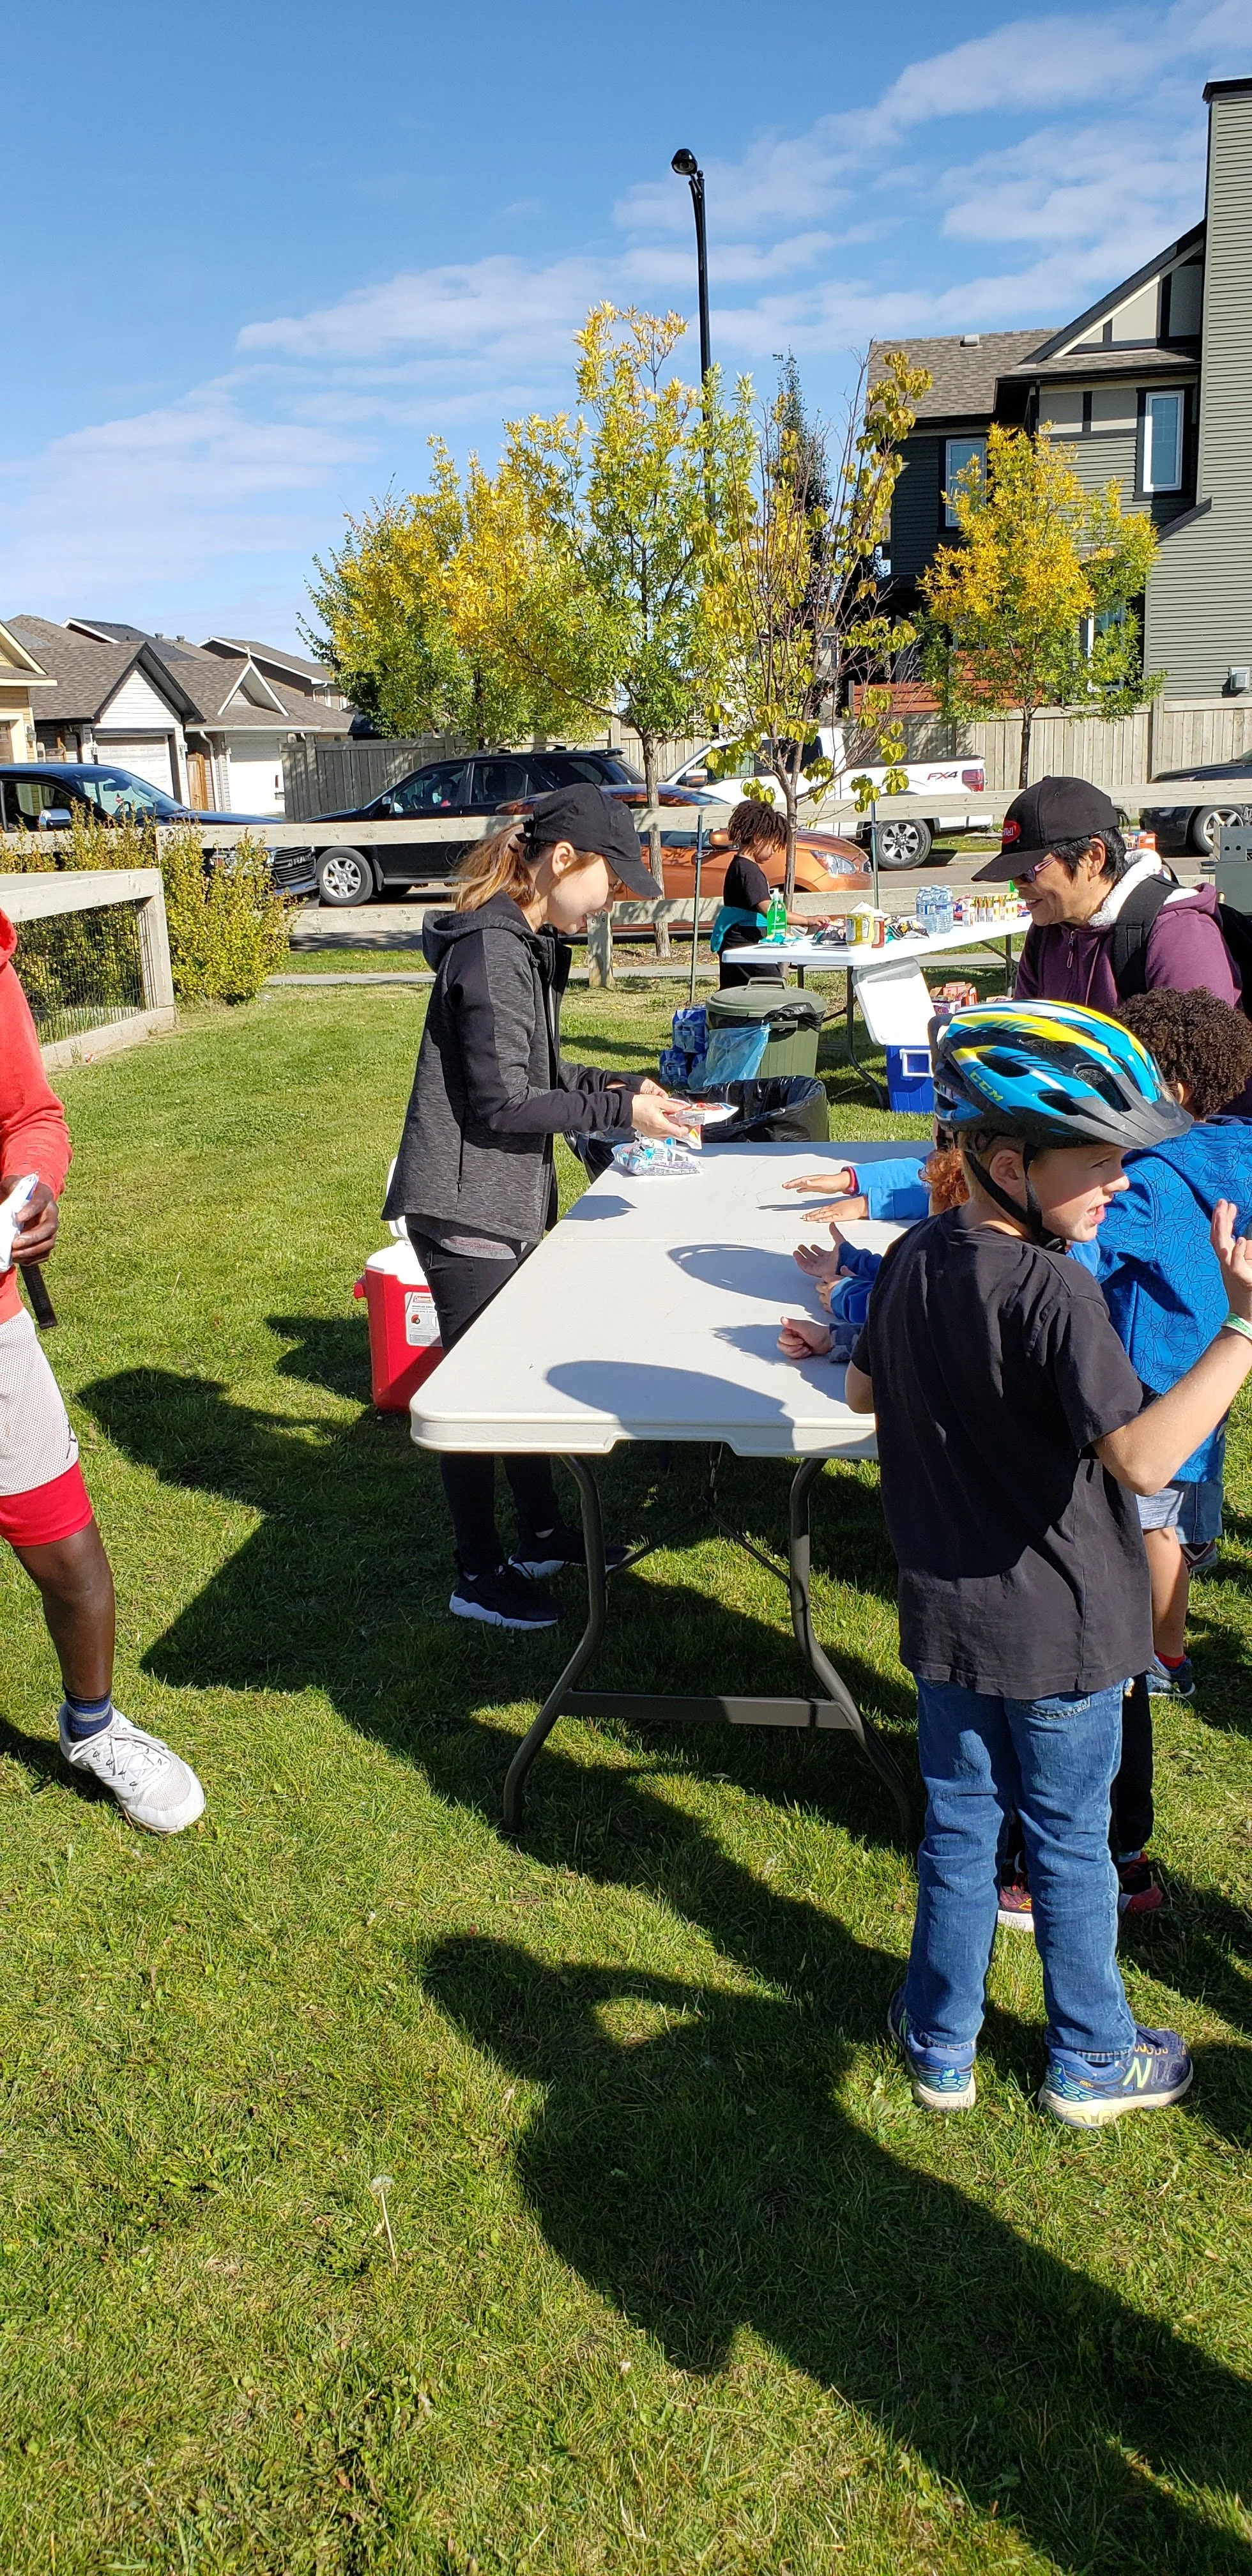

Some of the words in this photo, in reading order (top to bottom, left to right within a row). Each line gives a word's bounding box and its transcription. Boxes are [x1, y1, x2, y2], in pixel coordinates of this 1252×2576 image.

[927, 770, 958, 780] FX4
[970, 1071, 1004, 1101] CCM
[1122, 2057, 1152, 2089] N
